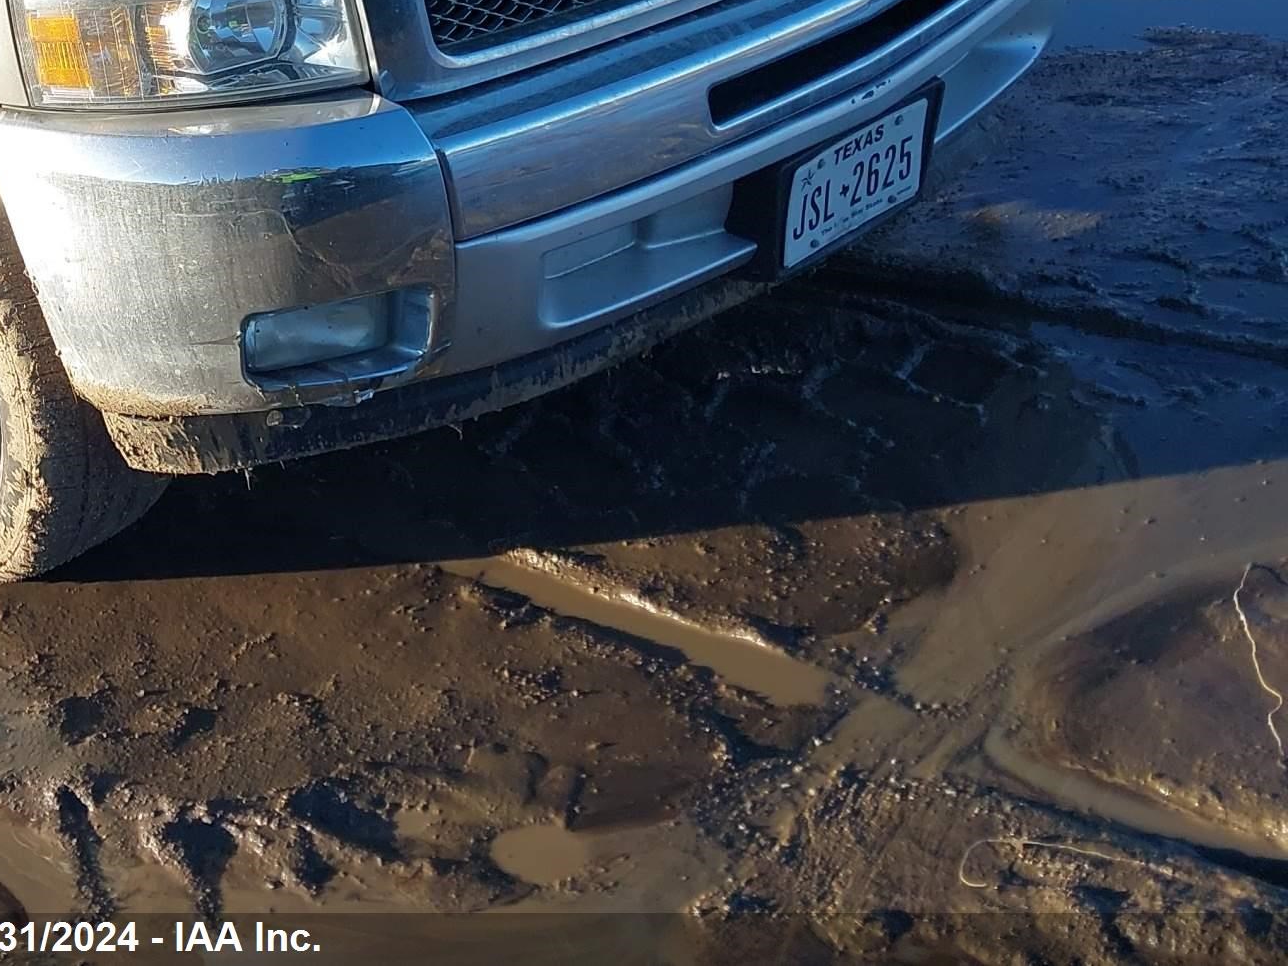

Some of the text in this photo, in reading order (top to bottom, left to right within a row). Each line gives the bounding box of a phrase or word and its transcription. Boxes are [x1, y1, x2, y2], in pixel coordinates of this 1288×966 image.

[833, 124, 885, 166] TEXAS
[793, 135, 914, 241] JSL 2625
